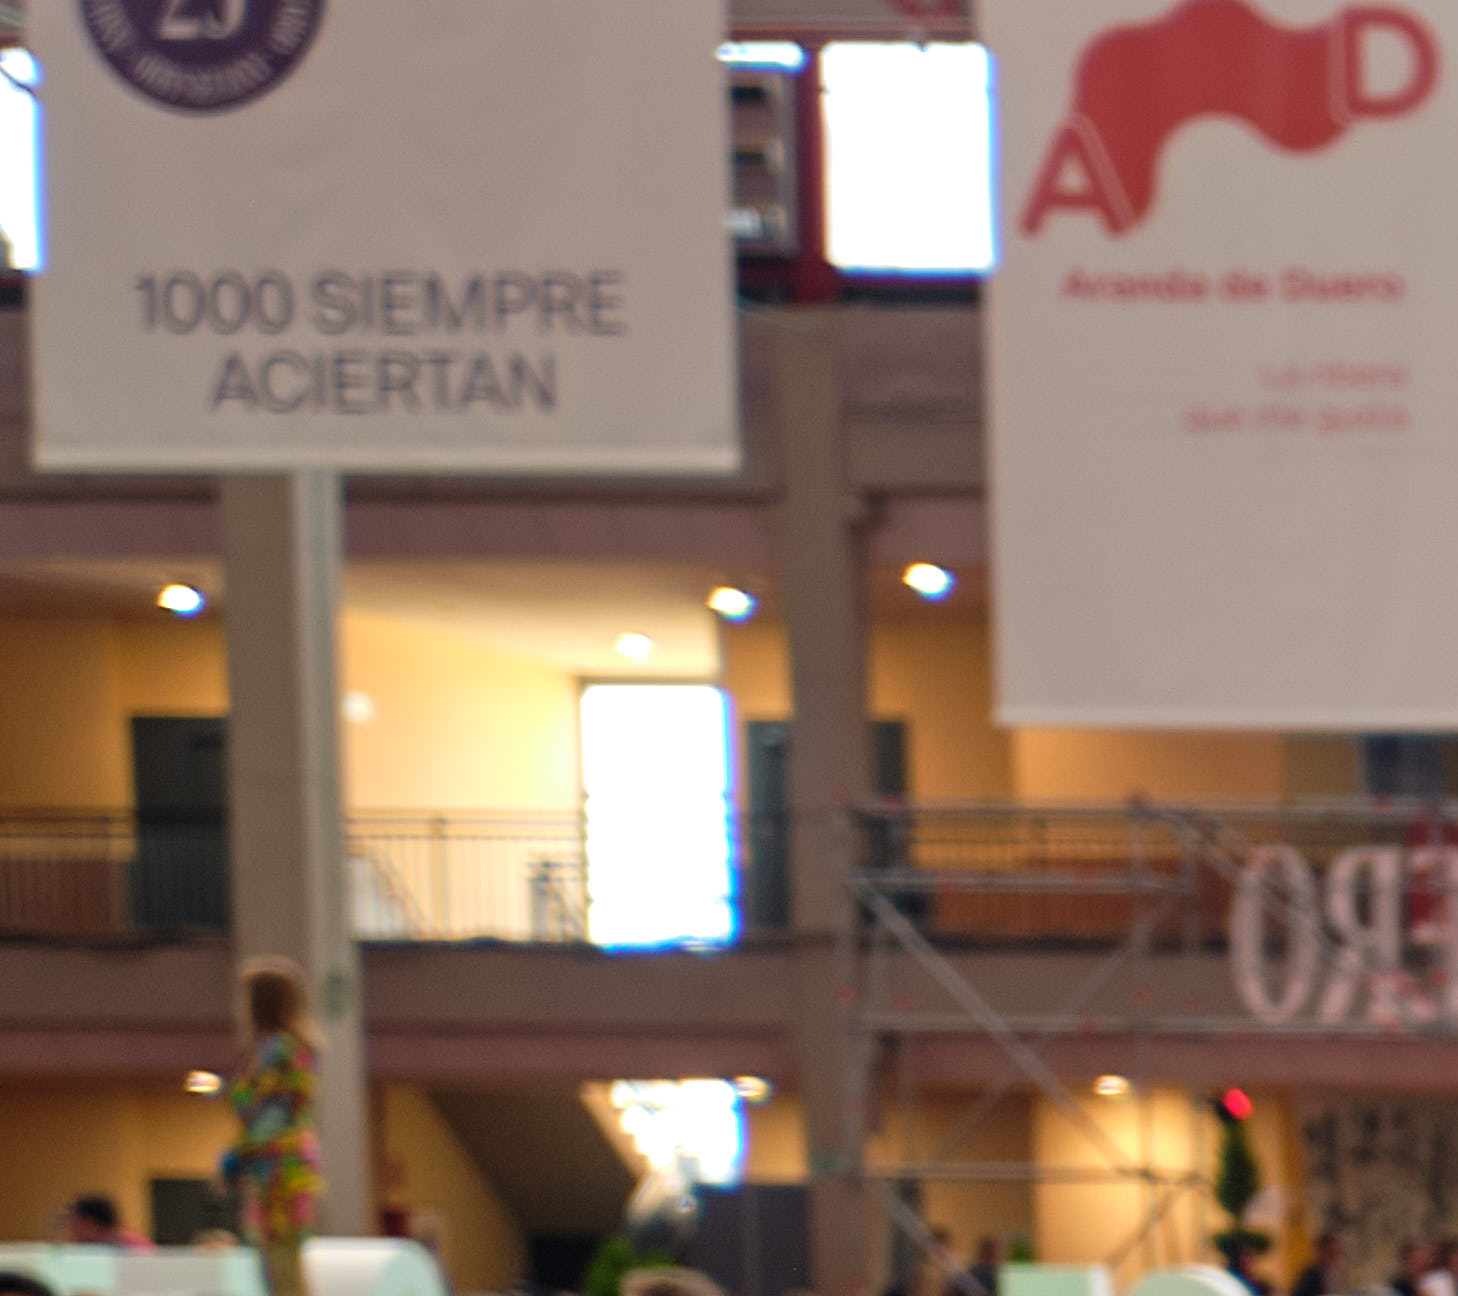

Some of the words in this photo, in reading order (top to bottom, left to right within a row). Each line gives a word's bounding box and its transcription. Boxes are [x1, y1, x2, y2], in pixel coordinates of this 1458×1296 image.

[135, 271, 295, 336] 1000
[311, 269, 626, 338] SIEMPRE
[208, 350, 558, 415] ACIERTAN
